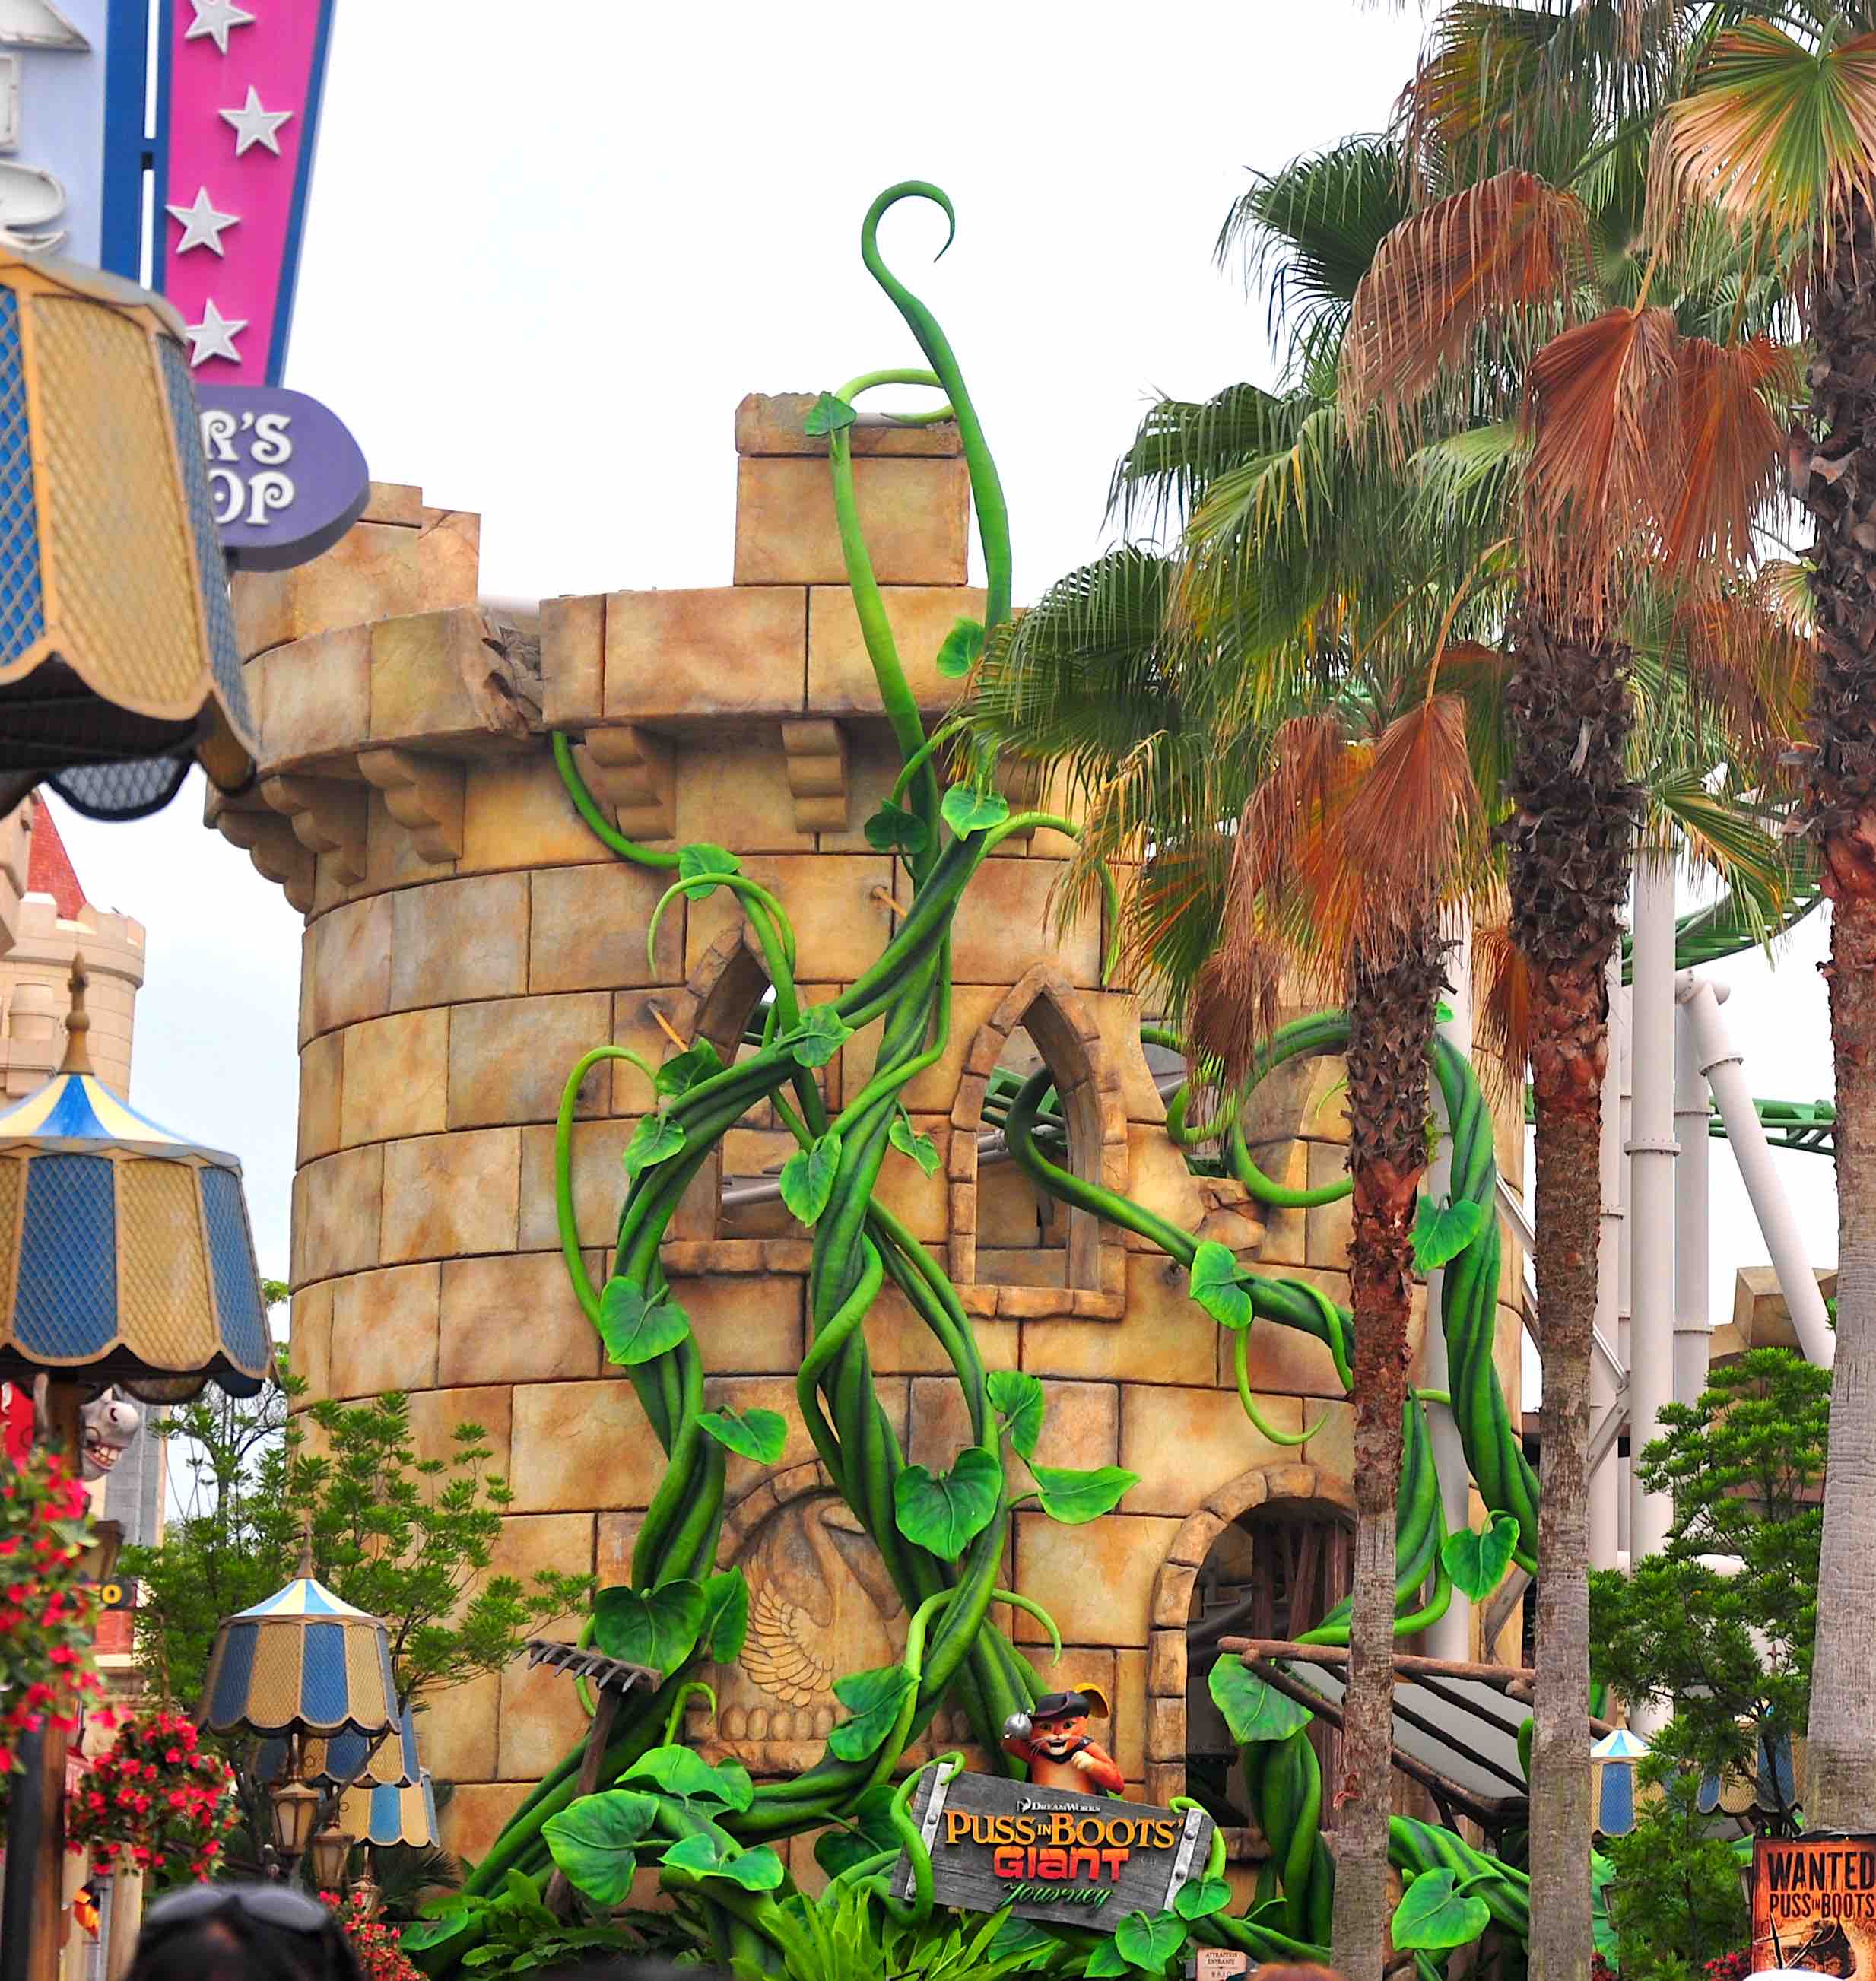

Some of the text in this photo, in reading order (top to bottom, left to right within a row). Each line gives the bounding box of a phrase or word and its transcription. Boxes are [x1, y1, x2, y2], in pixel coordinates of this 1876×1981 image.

[944, 1811, 1036, 1845] PUSS
[1037, 1824, 1052, 1836] IN
[1767, 1851, 1875, 1891] WANTED
[998, 1881, 1115, 1909] Journey
[1770, 1893, 1811, 1919] PUSS
[1821, 1892, 1875, 1919] BOOTS
